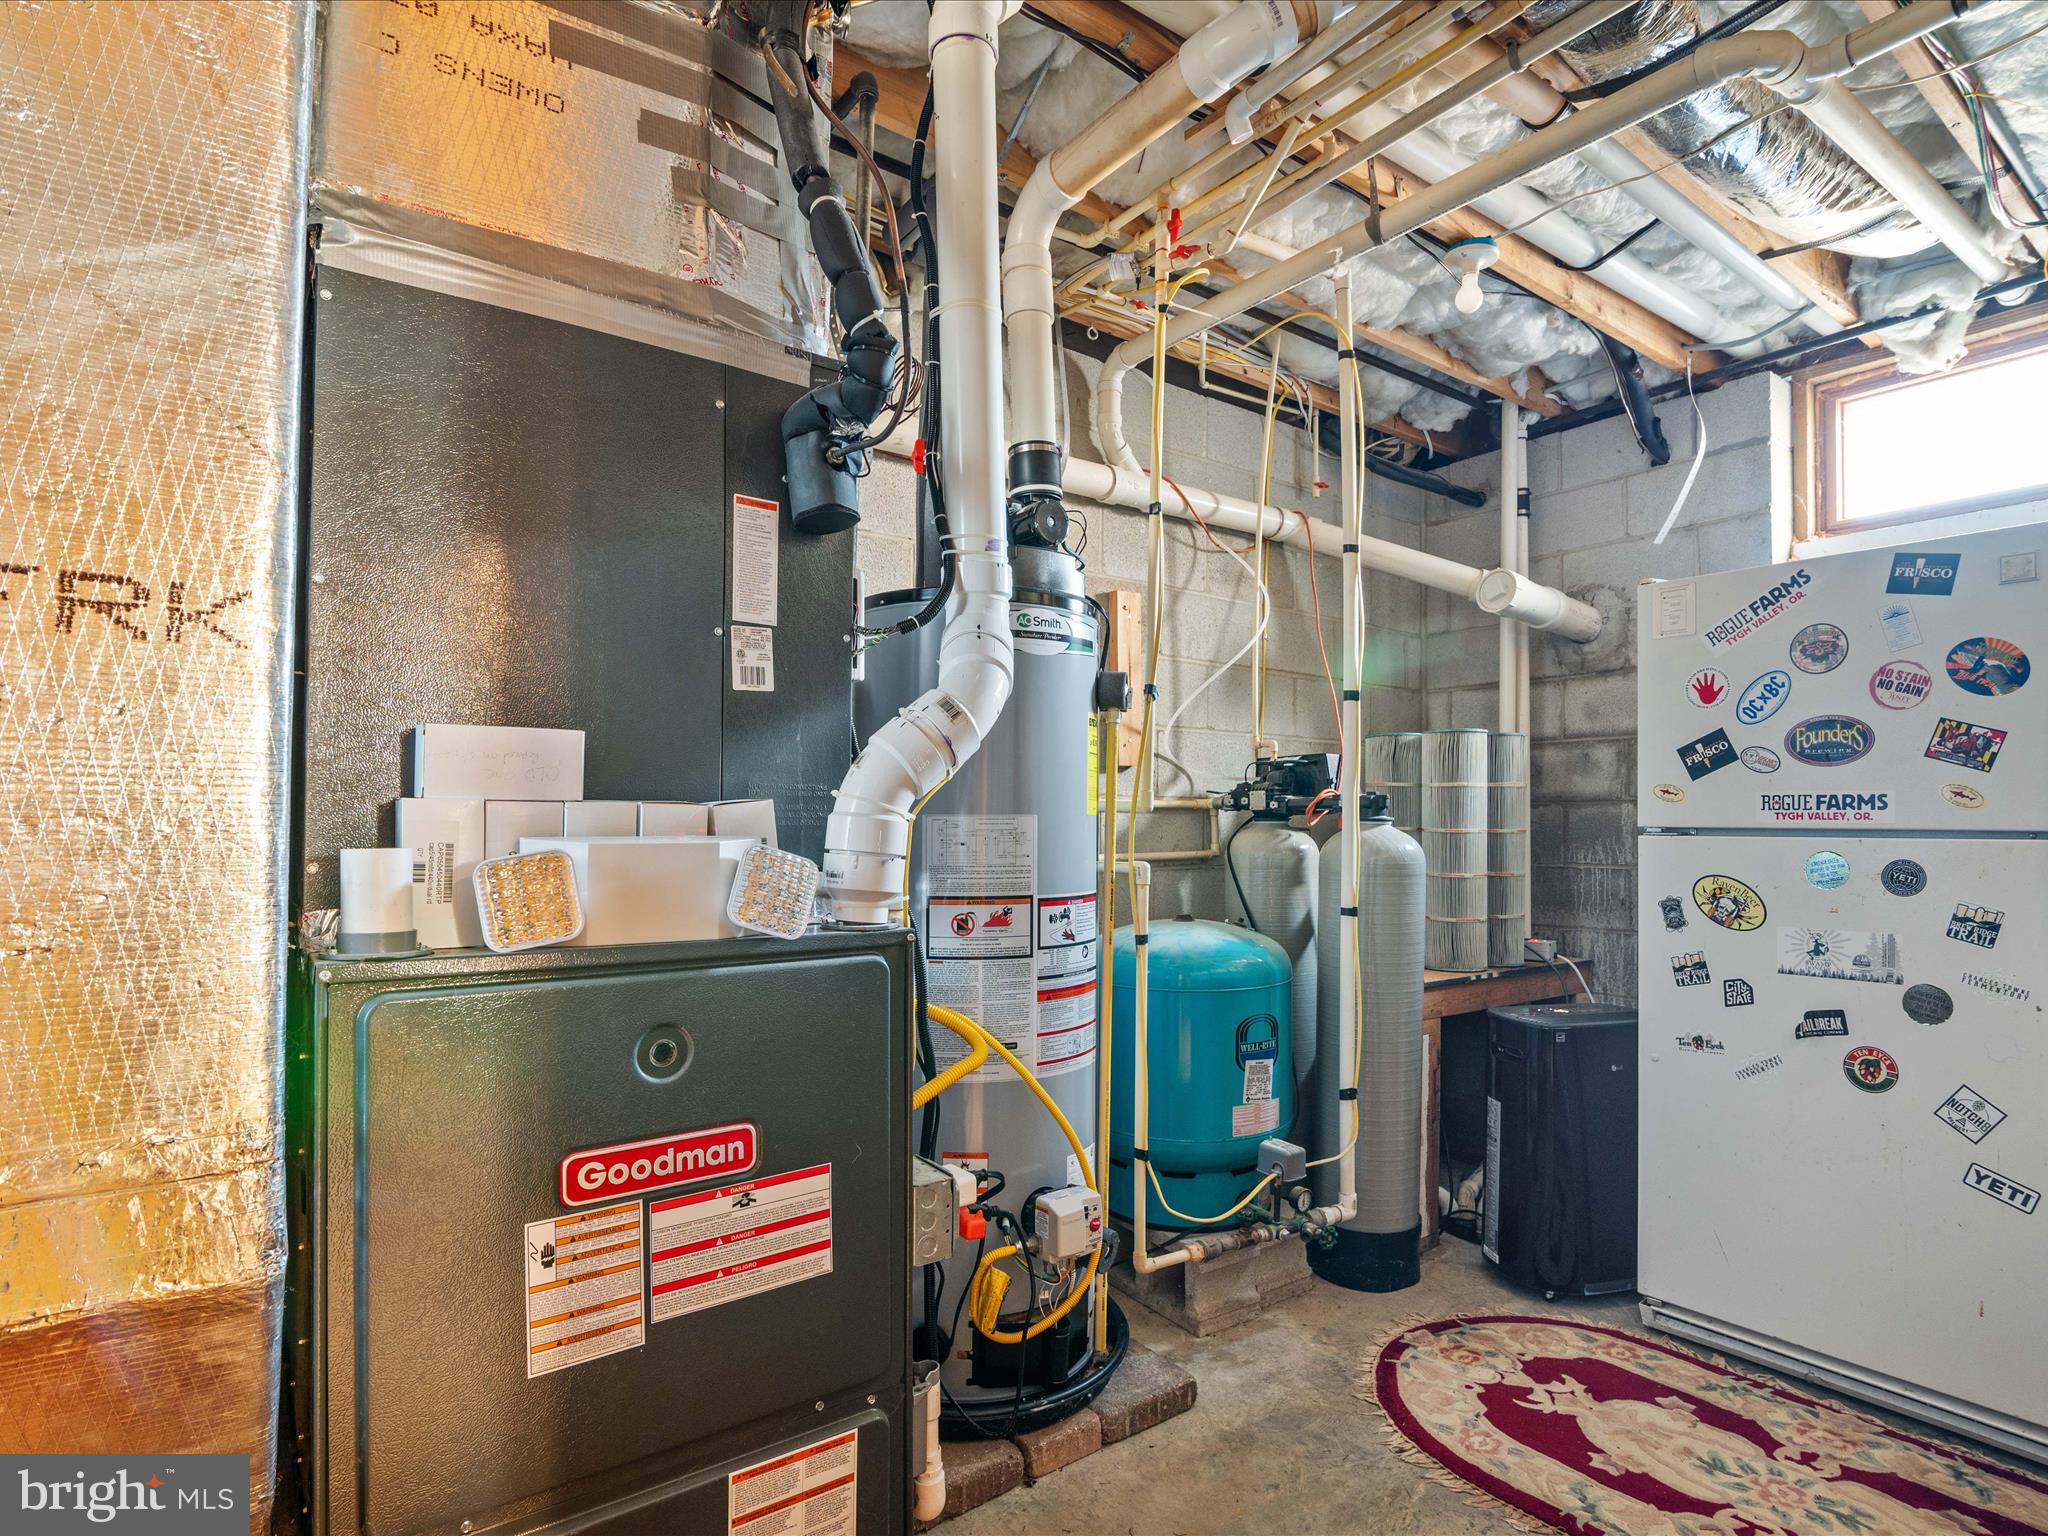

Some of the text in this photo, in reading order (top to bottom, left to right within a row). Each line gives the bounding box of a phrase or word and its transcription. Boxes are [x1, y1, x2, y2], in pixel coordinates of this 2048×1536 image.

[434, 52, 565, 114] OWENS
[1894, 566, 1953, 579] FRISCO
[1705, 608, 1753, 647] ROGUE
[1748, 569, 1812, 617] FARMS
[1033, 616, 1061, 629] Smith
[1726, 626, 1752, 646] TYGH
[1788, 591, 1808, 604] OR.
[1877, 667, 1931, 687] NO STAIN
[1877, 679, 1894, 690] NO
[1895, 681, 1925, 697] GAIN
[1685, 741, 1729, 767] FRISCO
[1760, 794, 1888, 811] ROGUE FARMS
[1775, 812, 1804, 821] TYGH
[1853, 812, 1873, 821] OR.
[1892, 871, 1918, 884] YETI
[1712, 877, 1761, 909] Raven Beer
[1951, 920, 1998, 938] BREW RIDGE
[1949, 927, 1994, 948] TRAIL
[1677, 973, 1711, 986] TRAIL
[1963, 972, 1999, 986] CHARLES
[1961, 977, 2030, 1001] FERMENTORY
[1726, 991, 1752, 1005] STATE
[1675, 1037, 1725, 1050] Ten Eyck
[1854, 1049, 1869, 1058] TEN
[577, 1138, 745, 1190] Goodman
[730, 1183, 755, 1195] DANGER
[1973, 1168, 2033, 1207] YETI
[587, 1208, 616, 1220] WARNING
[731, 1230, 756, 1242] DANGER
[731, 1262, 757, 1273] PELIGRO
